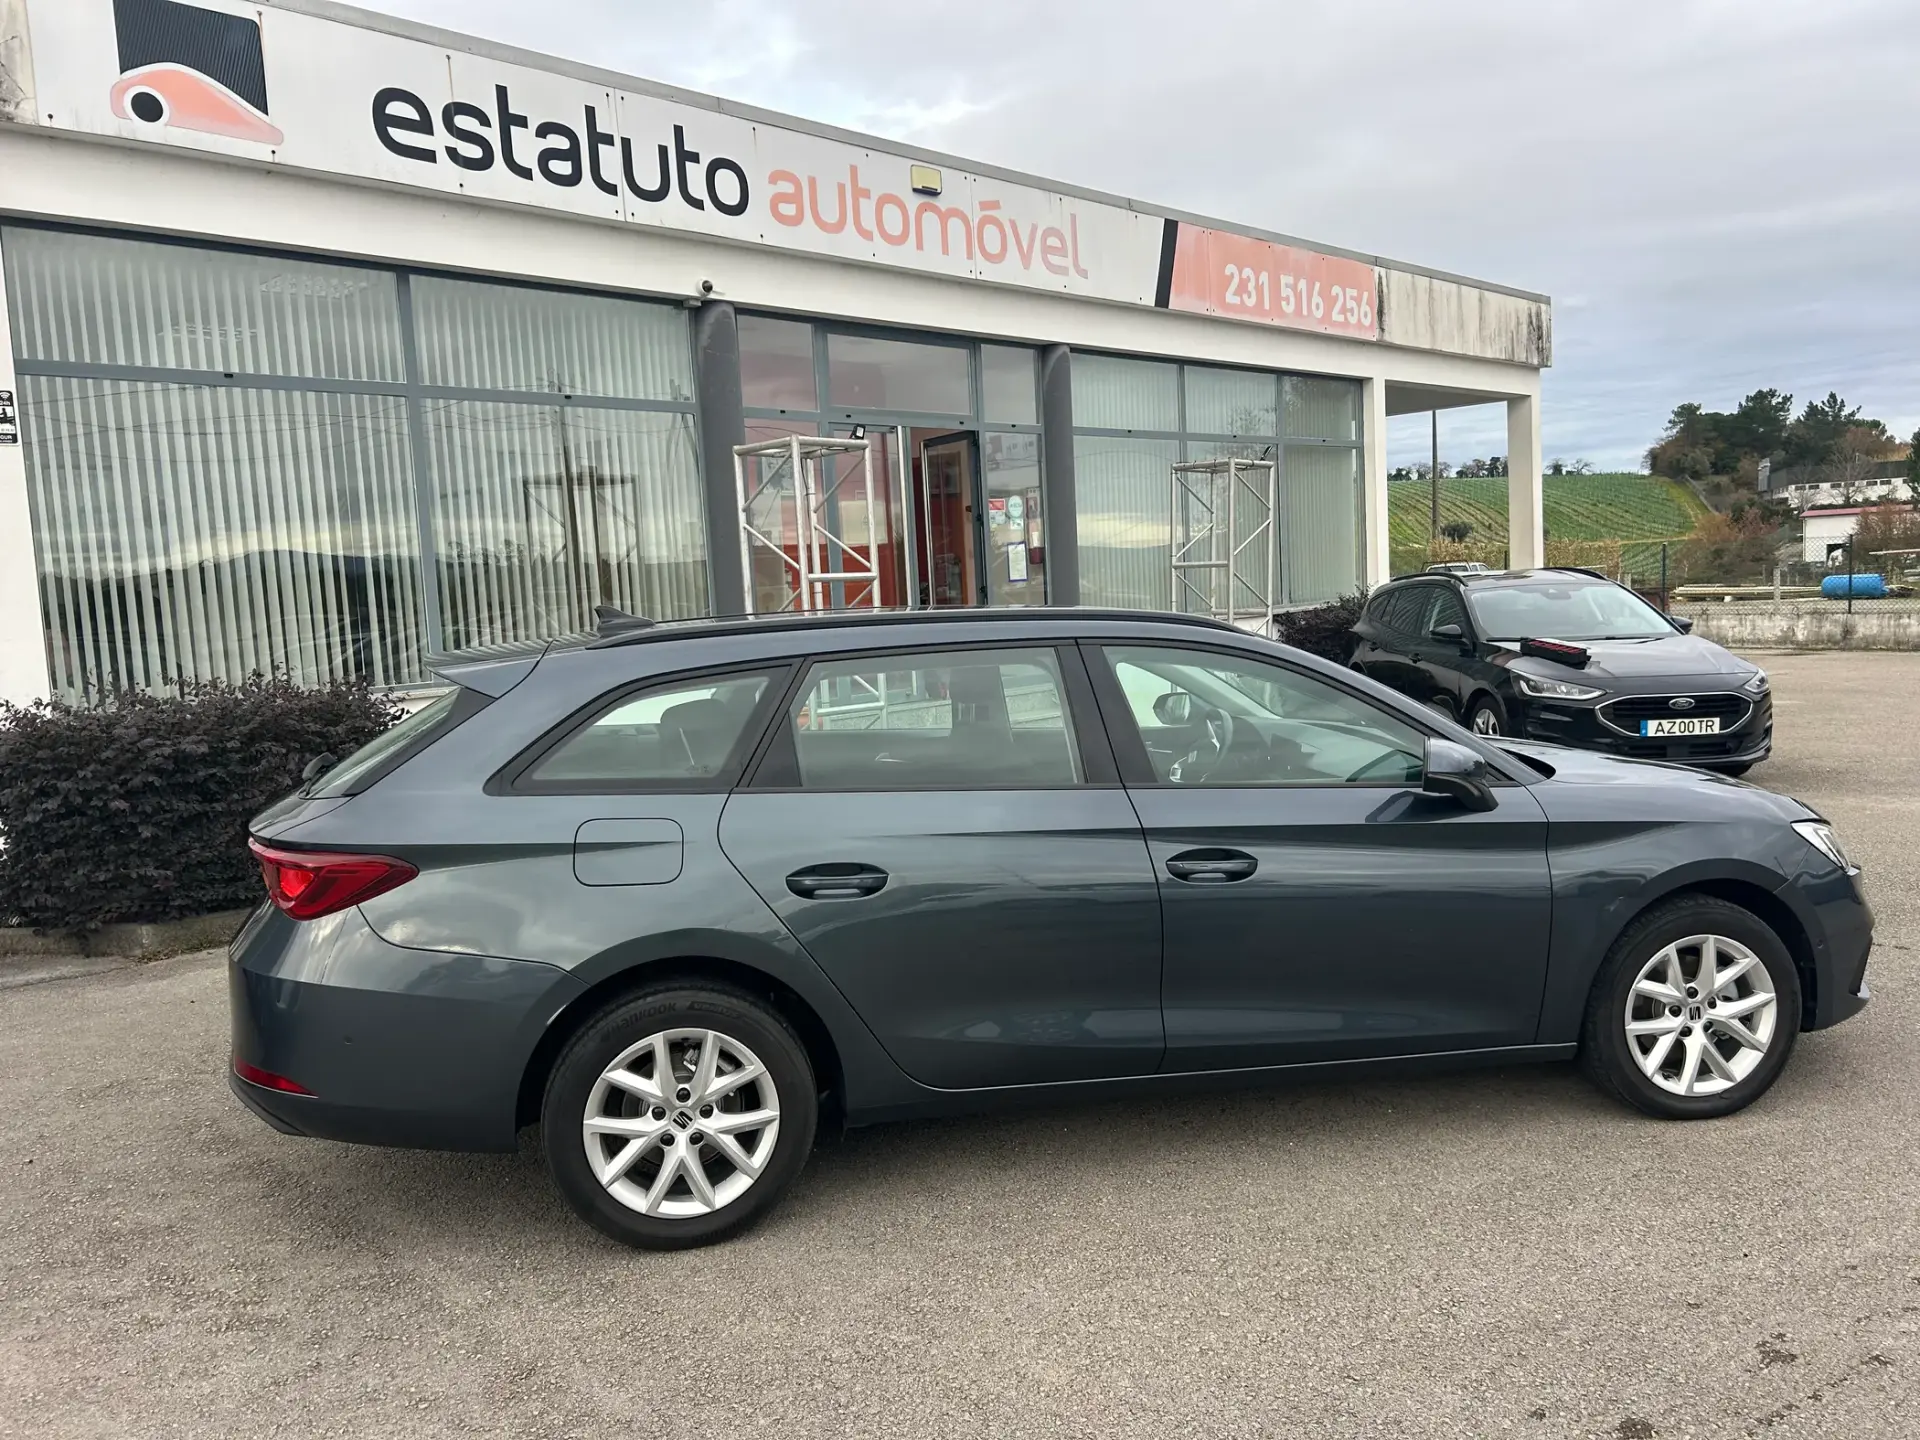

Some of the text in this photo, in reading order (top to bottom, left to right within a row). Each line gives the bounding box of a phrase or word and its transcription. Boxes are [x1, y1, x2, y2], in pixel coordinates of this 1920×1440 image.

[372, 83, 1089, 280] estatuto automóvel
[1224, 263, 1373, 328] 231 516 256
